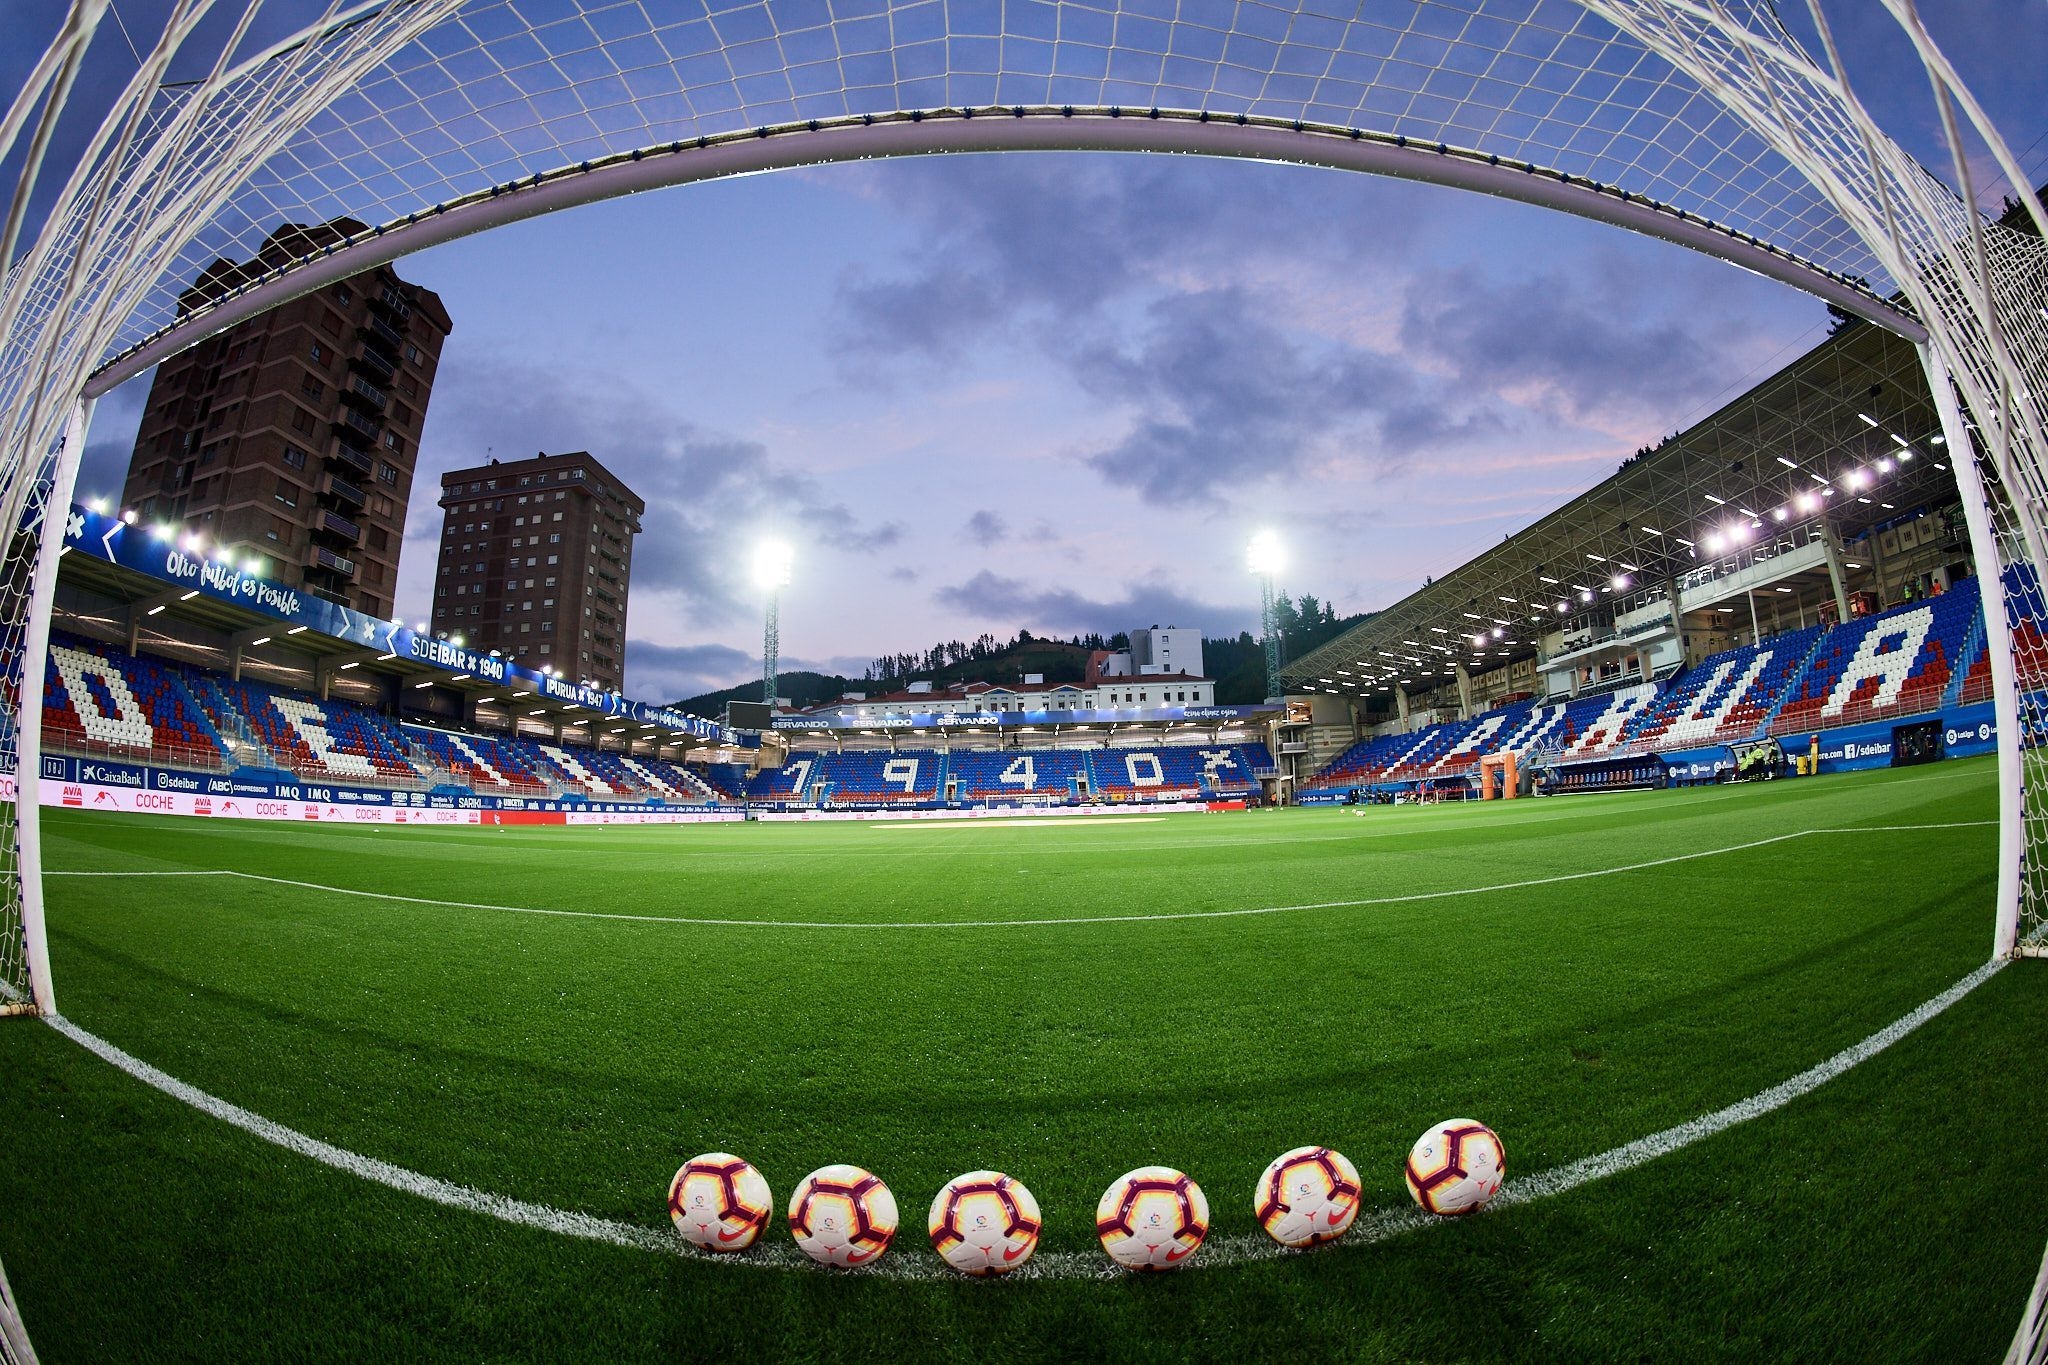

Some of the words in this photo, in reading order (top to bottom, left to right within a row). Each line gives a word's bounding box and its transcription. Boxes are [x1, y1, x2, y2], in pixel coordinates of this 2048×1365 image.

[166, 550, 199, 578] Otro
[241, 579, 256, 597] es
[256, 582, 300, 616] posible.
[479, 657, 503, 680] 1940
[546, 678, 577, 701] IPURUA
[586, 690, 604, 708] 1947
[771, 721, 829, 729] SERVANDO
[852, 719, 913, 727] SERVANDO
[937, 717, 999, 726] SERVANDO
[96, 767, 142, 785] CaixaBank
[168, 777, 199, 790] sdeibar
[275, 785, 301, 801] IMQ
[307, 787, 332, 803] IMQ
[136, 794, 174, 810] COCHE
[256, 803, 288, 816] COCHE
[355, 808, 382, 820] COCHE
[436, 811, 458, 822] COCHE
